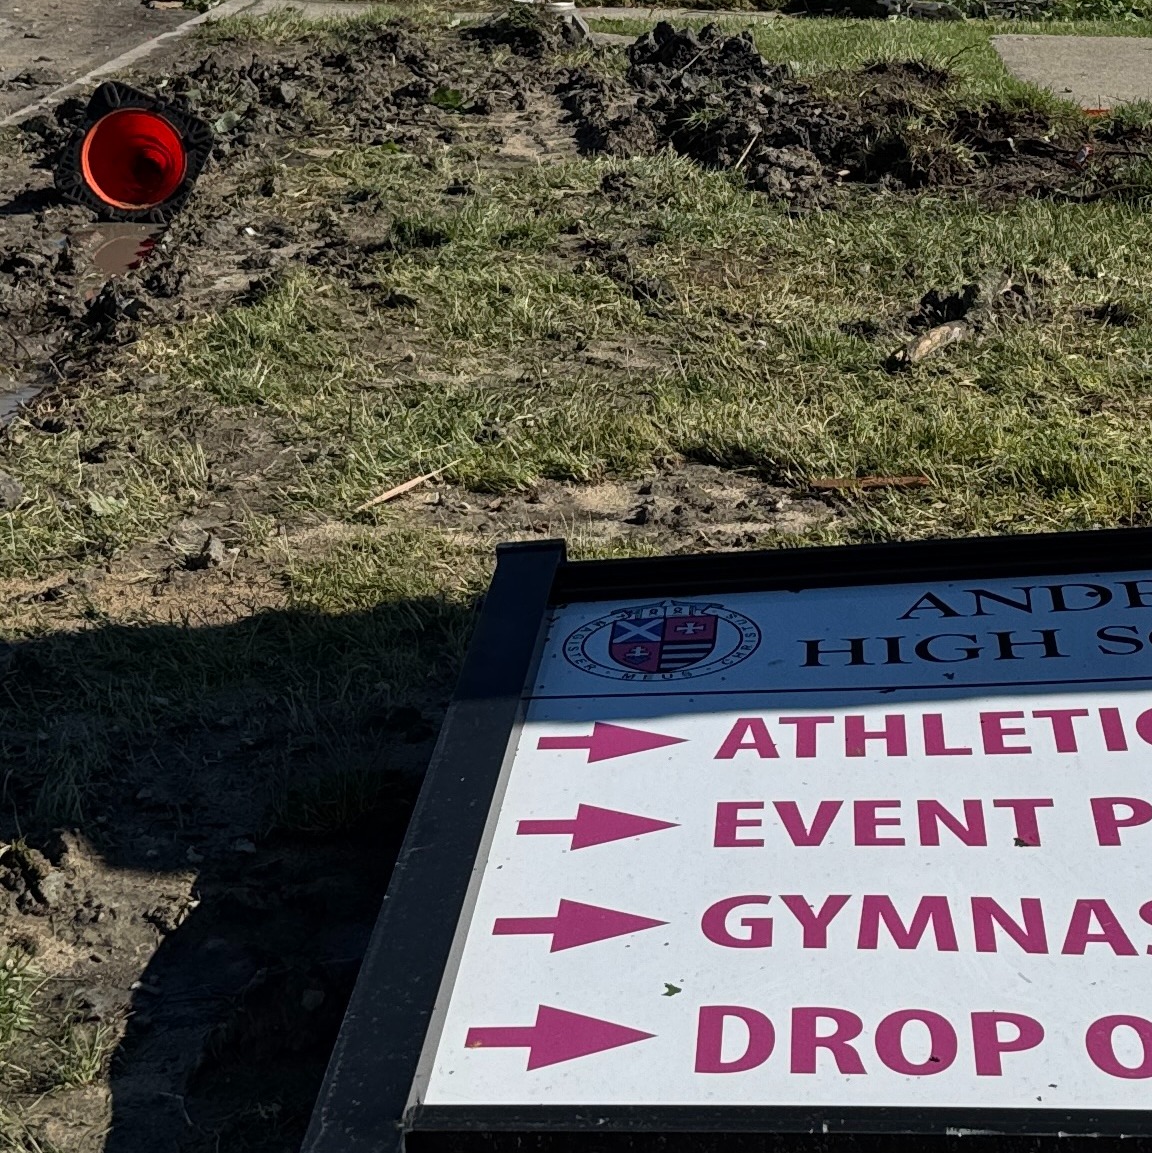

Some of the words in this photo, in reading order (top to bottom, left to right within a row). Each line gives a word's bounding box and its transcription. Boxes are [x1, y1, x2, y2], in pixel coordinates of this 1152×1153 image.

[567, 620, 606, 671] MAGISTER
[621, 670, 693, 680] MEUS
[721, 612, 757, 666] CHRISTUS
[800, 629, 1070, 668] HIGH
[713, 797, 1054, 848] EVENT
[694, 1005, 1045, 1077] DROP
